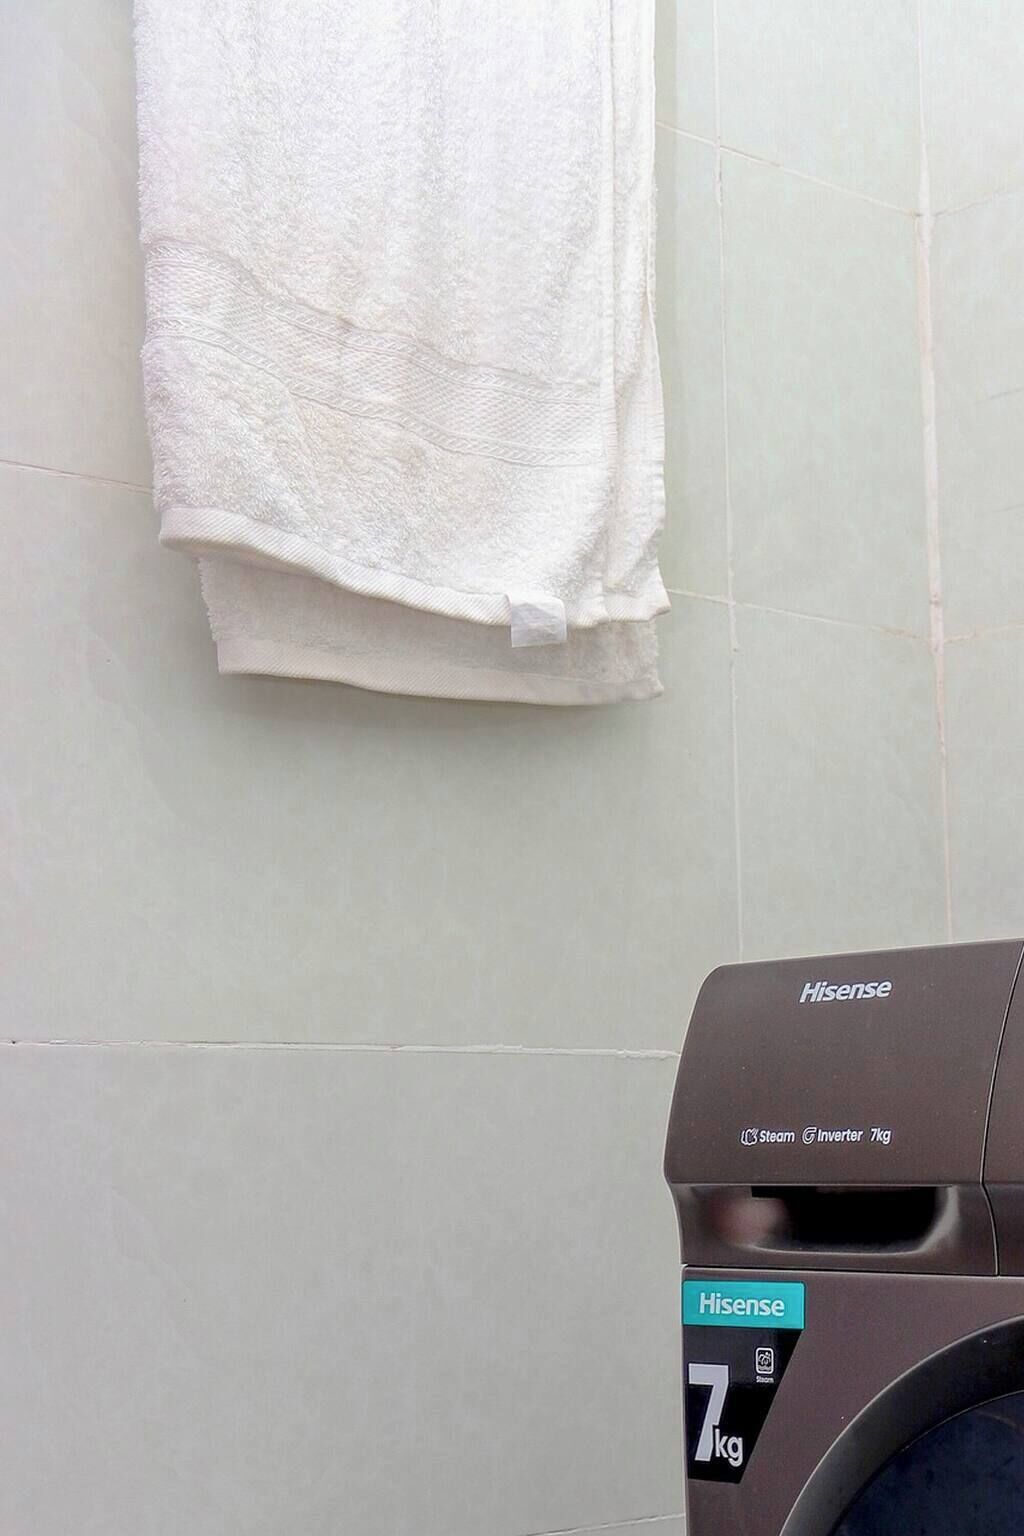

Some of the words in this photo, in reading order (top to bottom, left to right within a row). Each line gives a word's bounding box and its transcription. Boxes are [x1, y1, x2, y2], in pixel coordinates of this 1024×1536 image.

[799, 979, 893, 1003] Hisense
[759, 1130, 796, 1143] Steam
[817, 1128, 864, 1142] Inverter
[870, 1127, 892, 1145] 7kg
[699, 1292, 785, 1317] Hisense
